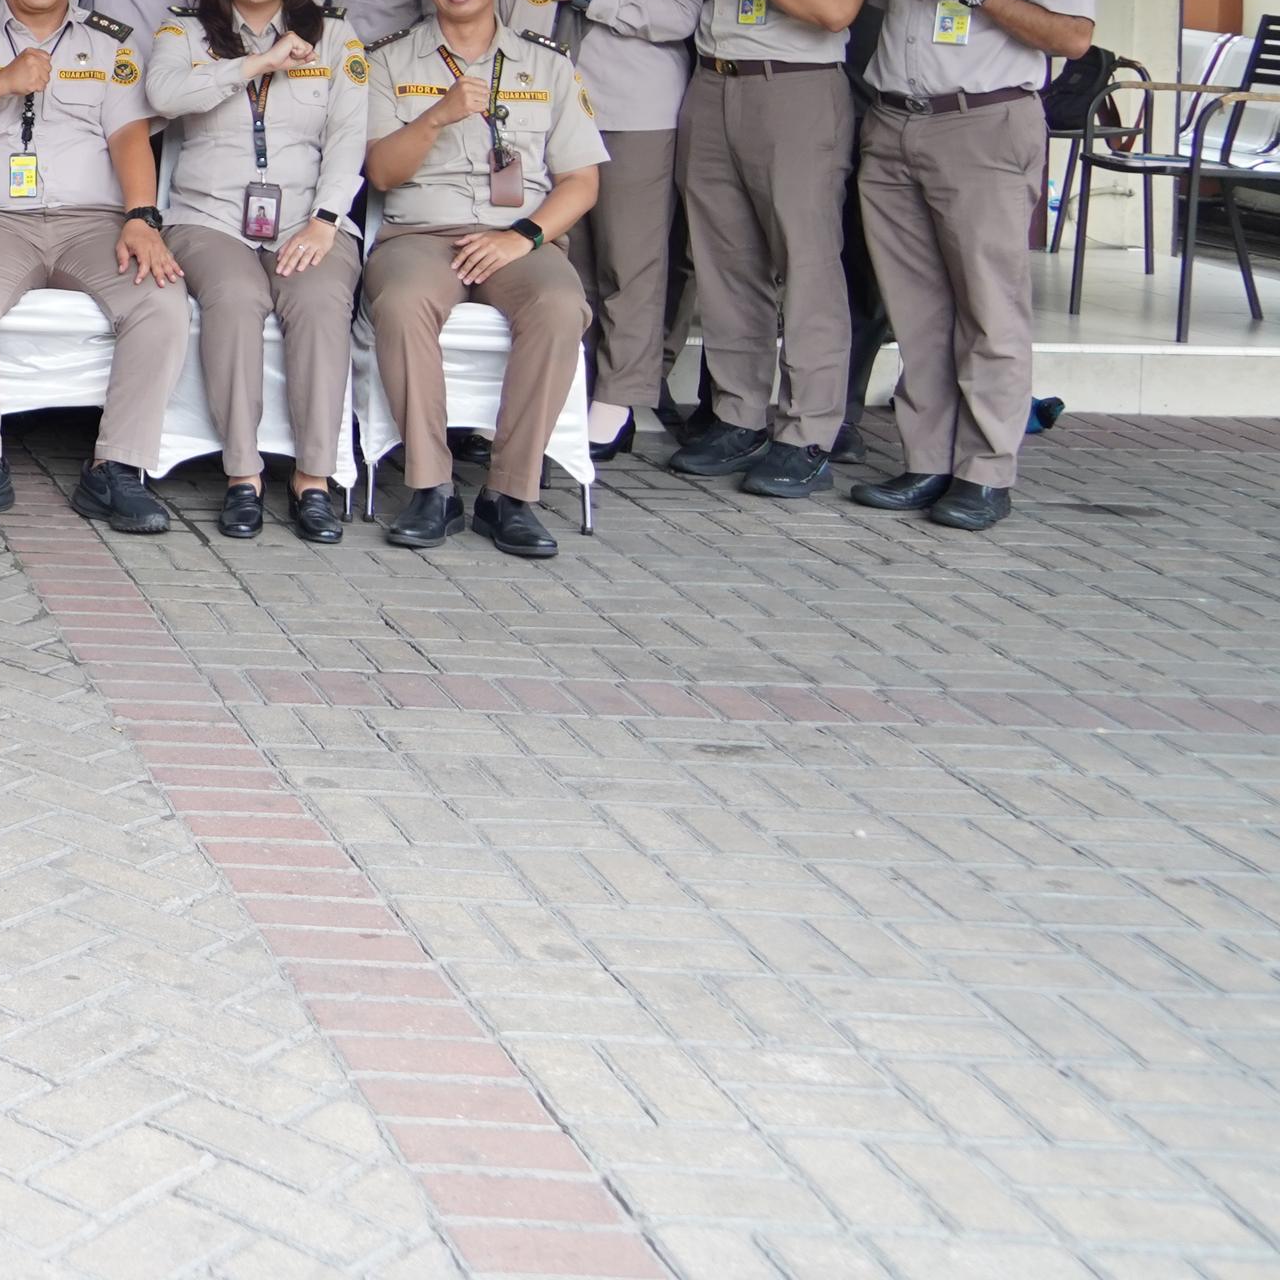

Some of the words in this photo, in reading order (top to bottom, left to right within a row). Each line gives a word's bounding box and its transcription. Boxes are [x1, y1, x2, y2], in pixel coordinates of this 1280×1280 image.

[59, 71, 106, 80] QUARANTINE
[406, 85, 438, 94] INDRA
[497, 91, 548, 101] QUARANTINE
